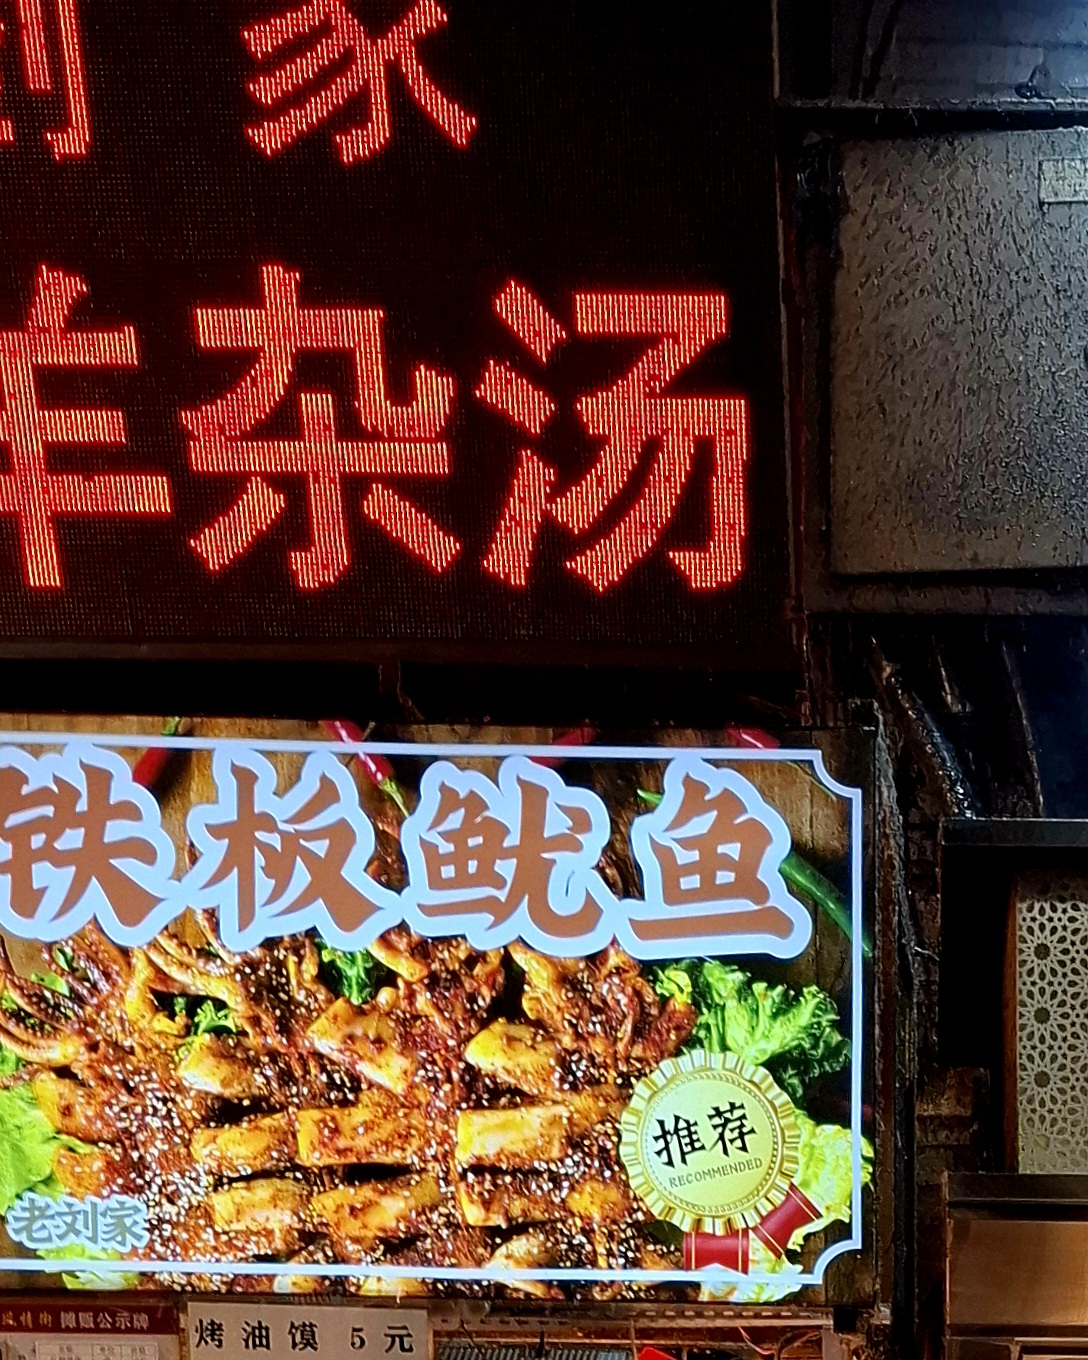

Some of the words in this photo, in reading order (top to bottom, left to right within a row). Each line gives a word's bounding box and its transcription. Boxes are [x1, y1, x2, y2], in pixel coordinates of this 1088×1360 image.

[0, 262, 747, 592] 羊杂汤
[0, 756, 797, 944] 铁板鱿鱼
[653, 1101, 757, 1168] 推荐
[668, 1157, 763, 1189] RECOMMENDED
[11, 1198, 145, 1247] 老刘家
[195, 1319, 319, 1351] 烤油馍
